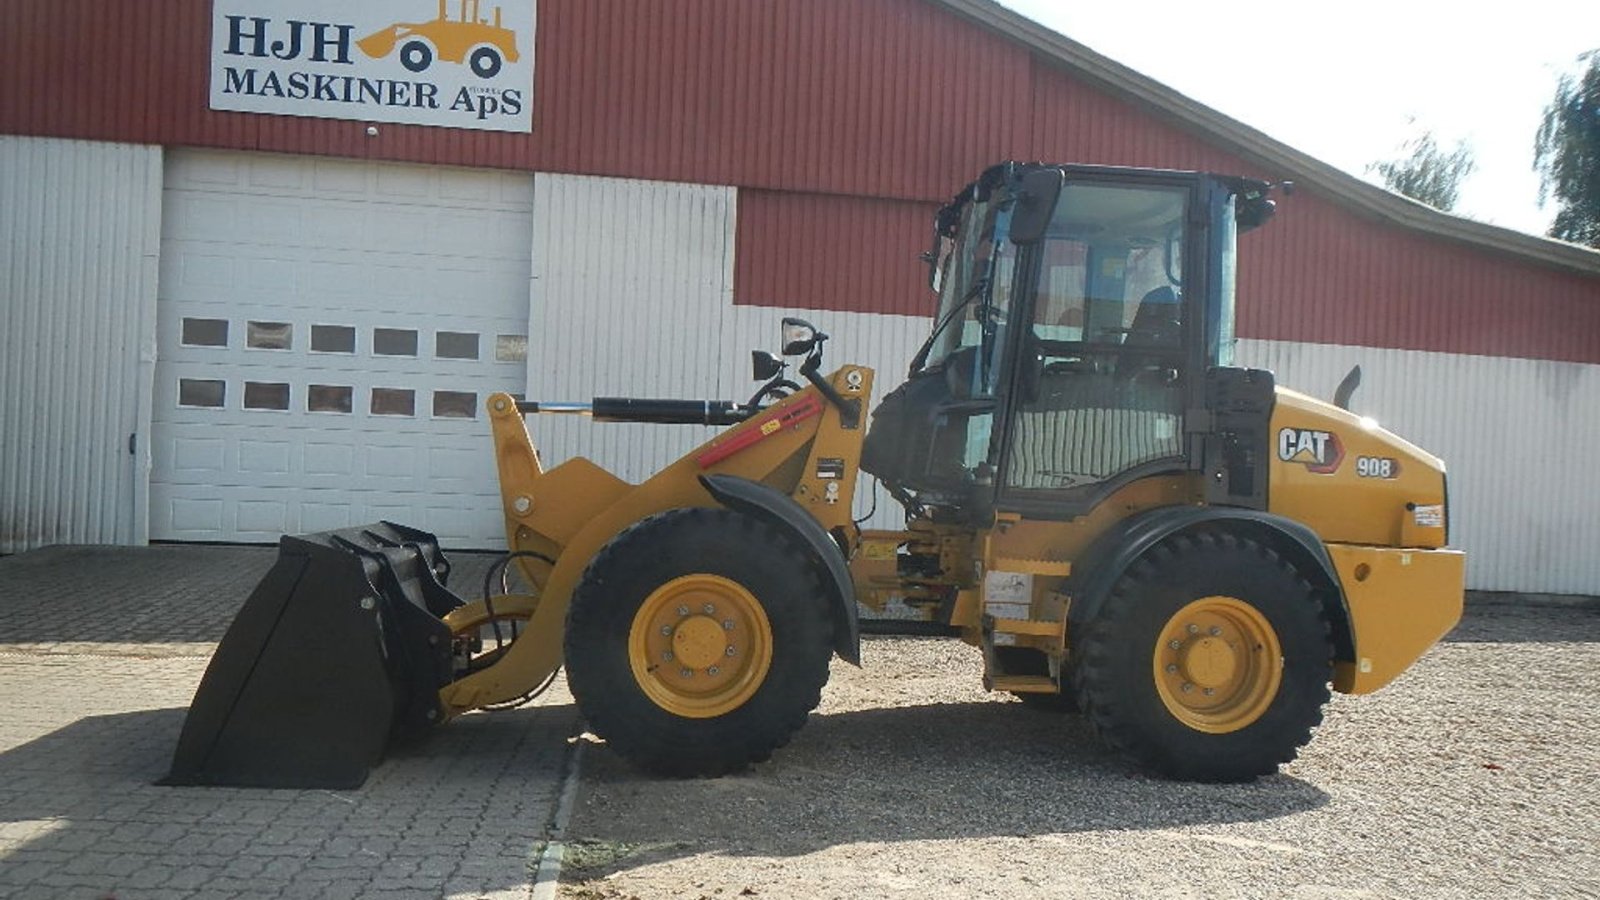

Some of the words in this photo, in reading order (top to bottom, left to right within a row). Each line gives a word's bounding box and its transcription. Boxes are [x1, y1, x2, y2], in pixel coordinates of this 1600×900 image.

[223, 15, 355, 64] HJH
[222, 67, 440, 109] MASKINER
[449, 86, 522, 119] ApS
[1279, 427, 1330, 464] CAT
[1357, 457, 1392, 478] 908
